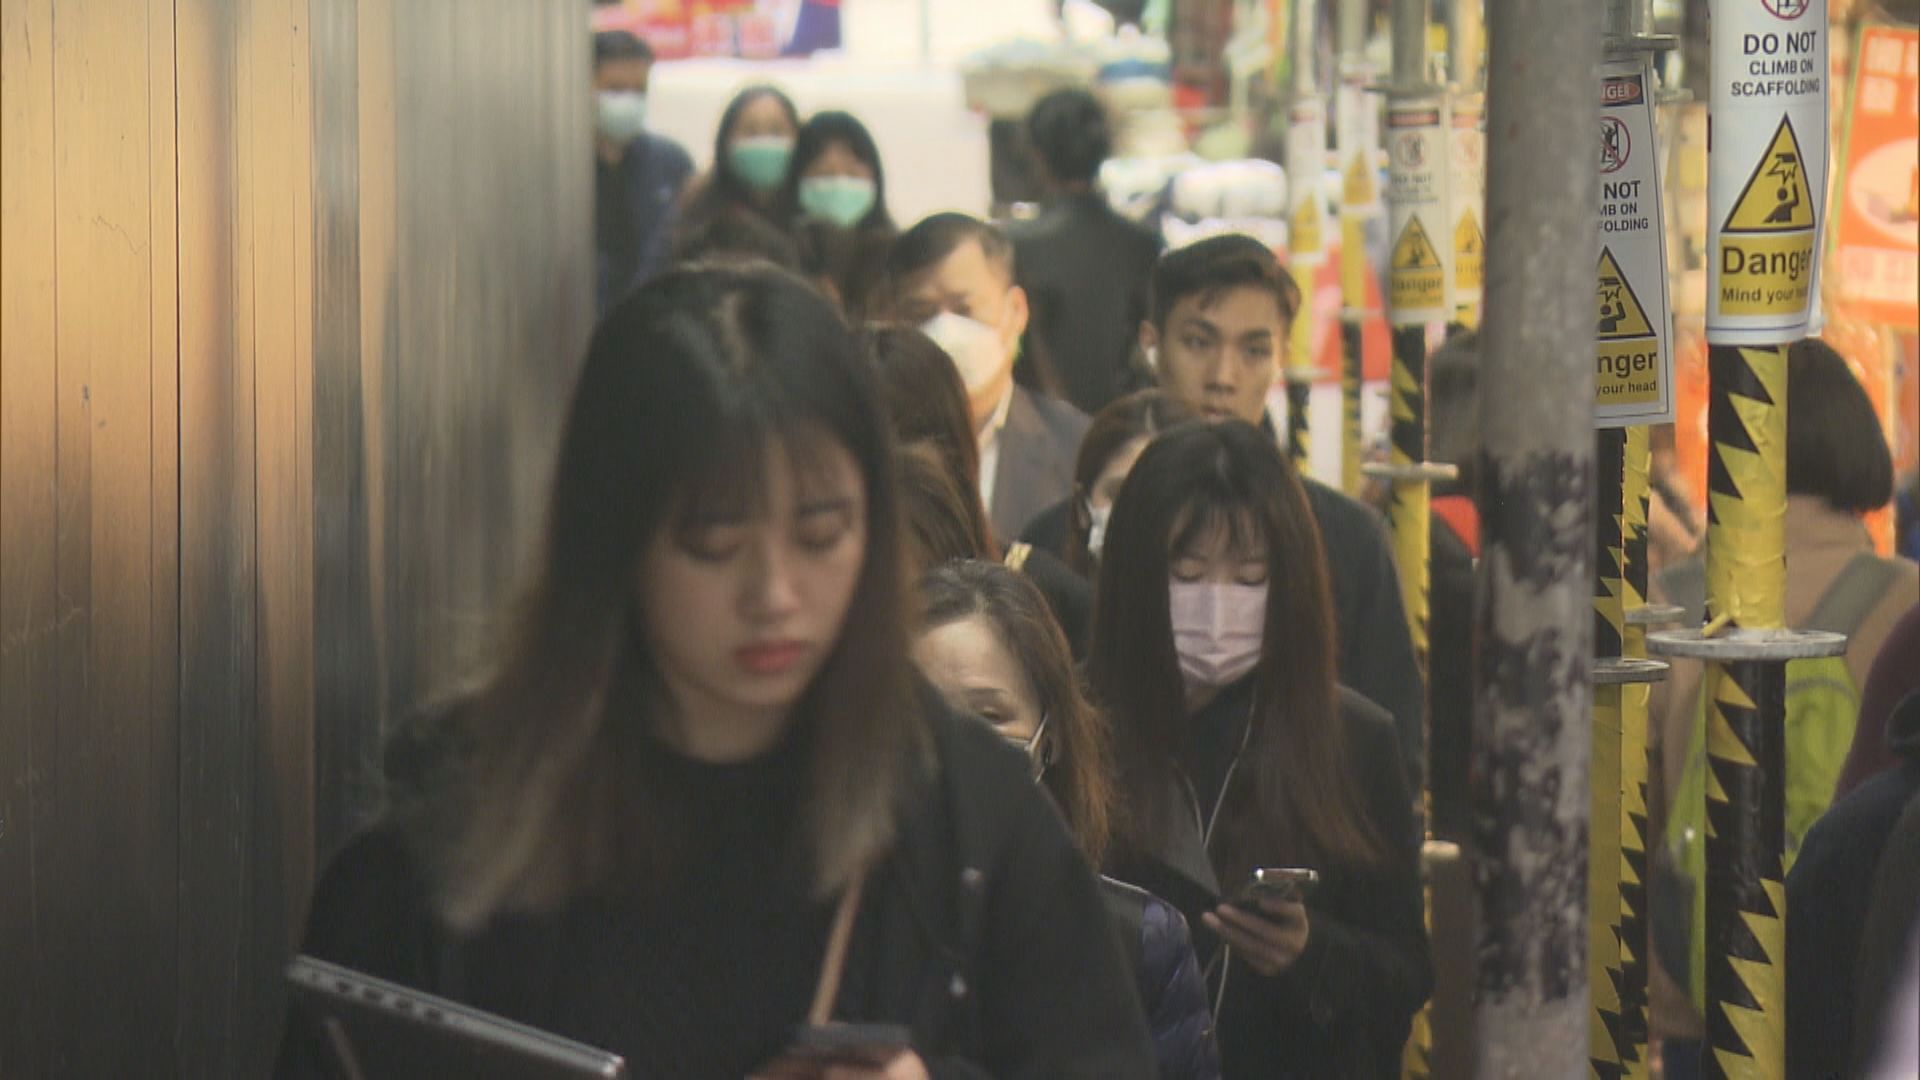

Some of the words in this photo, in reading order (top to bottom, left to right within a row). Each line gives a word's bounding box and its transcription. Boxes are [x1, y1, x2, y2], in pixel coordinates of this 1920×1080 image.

[1743, 33, 1779, 55] DO
[1786, 30, 1816, 54] NOT
[1749, 60, 1797, 75] CLIMB
[1800, 58, 1813, 74] ON
[1731, 78, 1819, 97] SCAFFOLDING
[1604, 180, 1641, 200] NOT
[1620, 202, 1637, 215] ON
[1722, 288, 1762, 302] Mind
[1767, 288, 1795, 305] your
[1597, 352, 1657, 379] nger
[1628, 381, 1656, 393] head
